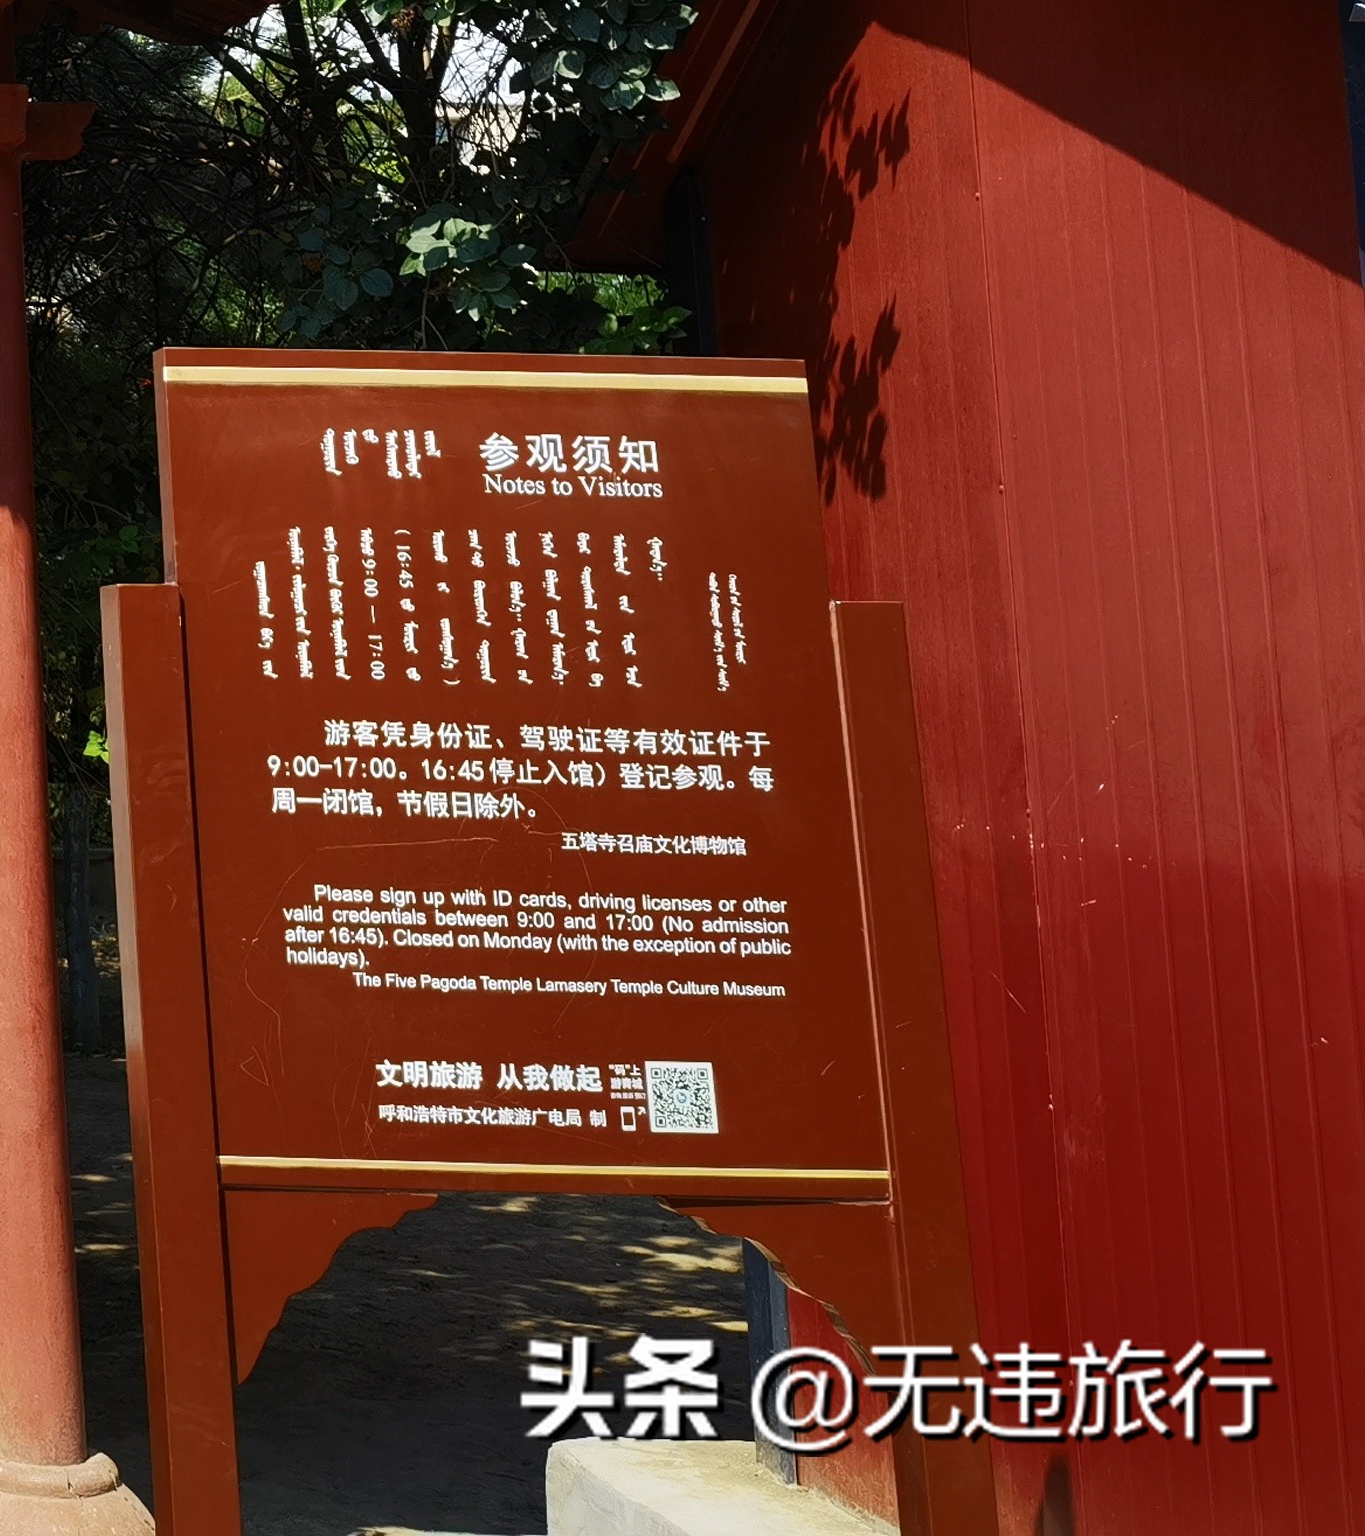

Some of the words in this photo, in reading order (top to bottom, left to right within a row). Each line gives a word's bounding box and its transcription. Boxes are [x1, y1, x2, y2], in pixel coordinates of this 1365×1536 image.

[479, 432, 660, 475] 参观须知
[481, 473, 546, 495] Notes
[550, 477, 573, 495] to
[577, 475, 663, 497] Visitors
[324, 719, 770, 757] 游客凭身份证、驾驶证等有效证件于
[271, 787, 536, 819] 周一闭馆，节假日除外。
[561, 831, 747, 856] 五塔寺召庙文化博物馆
[313, 884, 373, 903] Please
[379, 886, 416, 906] sign
[422, 891, 444, 907] up
[450, 887, 486, 906] with
[492, 889, 512, 906] ID
[519, 891, 571, 910] cards,
[577, 891, 636, 913] driving
[641, 893, 712, 912] licenses
[718, 899, 737, 912] or
[742, 896, 787, 913] other
[282, 904, 323, 923] valid
[332, 905, 427, 925] credentials
[434, 906, 508, 927] between
[516, 911, 554, 928] 9:00
[563, 913, 596, 929] and
[605, 911, 653, 931] 17:00
[661, 915, 693, 935] (No
[701, 916, 789, 934] admission
[284, 925, 324, 943] after
[328, 926, 388, 948] 16:45).
[392, 928, 454, 947] Closed
[457, 934, 479, 947] on
[483, 930, 552, 953] Monday
[556, 933, 597, 953] (with
[600, 934, 629, 951] the
[632, 936, 715, 956] exception
[718, 936, 736, 954] of
[739, 937, 791, 957] public
[286, 945, 369, 969] holidays).
[351, 971, 381, 987] The
[384, 972, 416, 988] Five
[419, 973, 477, 992] Pagoda
[479, 975, 532, 994] Temple
[535, 977, 607, 996] Lamasery
[609, 978, 663, 996] Temple
[666, 979, 719, 995] Culture
[722, 981, 785, 996] Museum
[375, 1059, 483, 1090] 文明旅游
[496, 1063, 603, 1092] 从我做起
[378, 1104, 582, 1128] 呼和浩特市文化旅游广电局
[590, 1109, 607, 1128] 制
